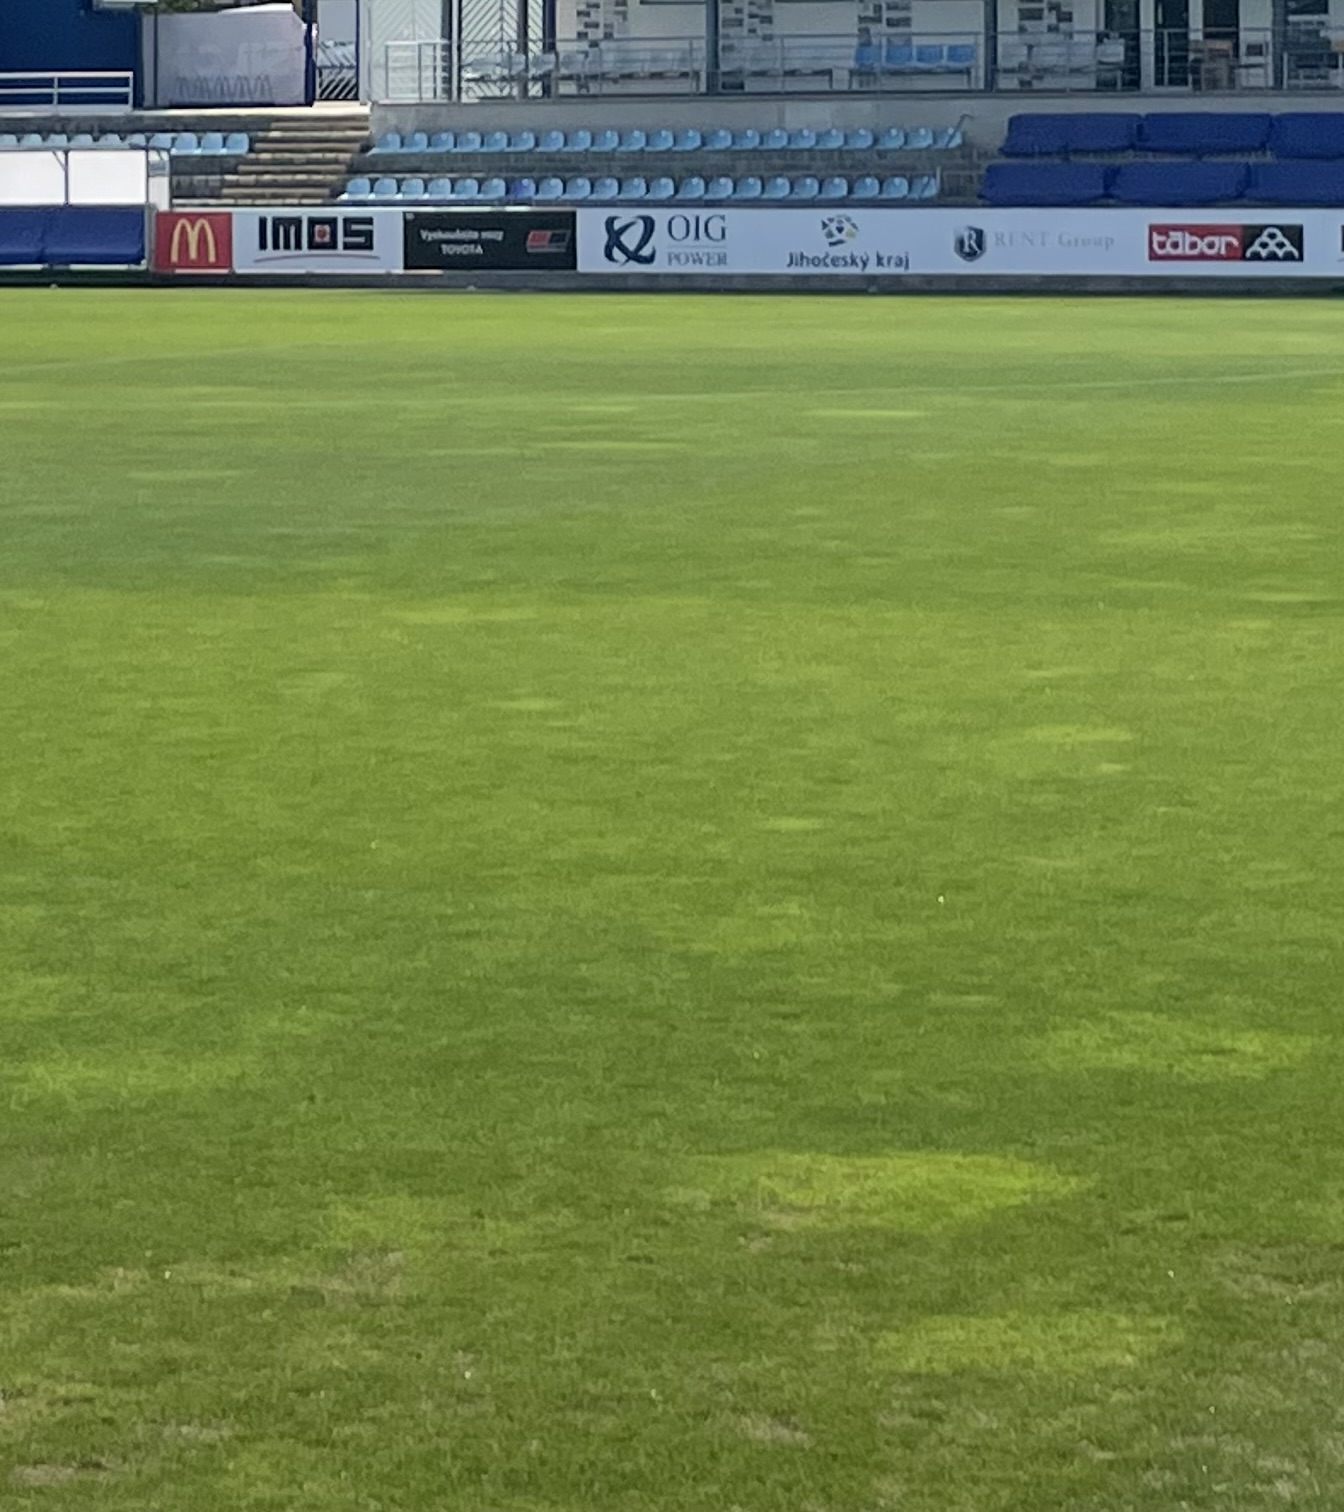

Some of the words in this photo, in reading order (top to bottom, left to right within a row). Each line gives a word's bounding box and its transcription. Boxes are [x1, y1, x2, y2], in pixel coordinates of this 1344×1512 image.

[667, 214, 728, 242] OIG
[1058, 231, 1115, 252] Group
[667, 251, 728, 267] POWER
[786, 250, 870, 272] Jihočeský
[876, 250, 910, 271] kraj
